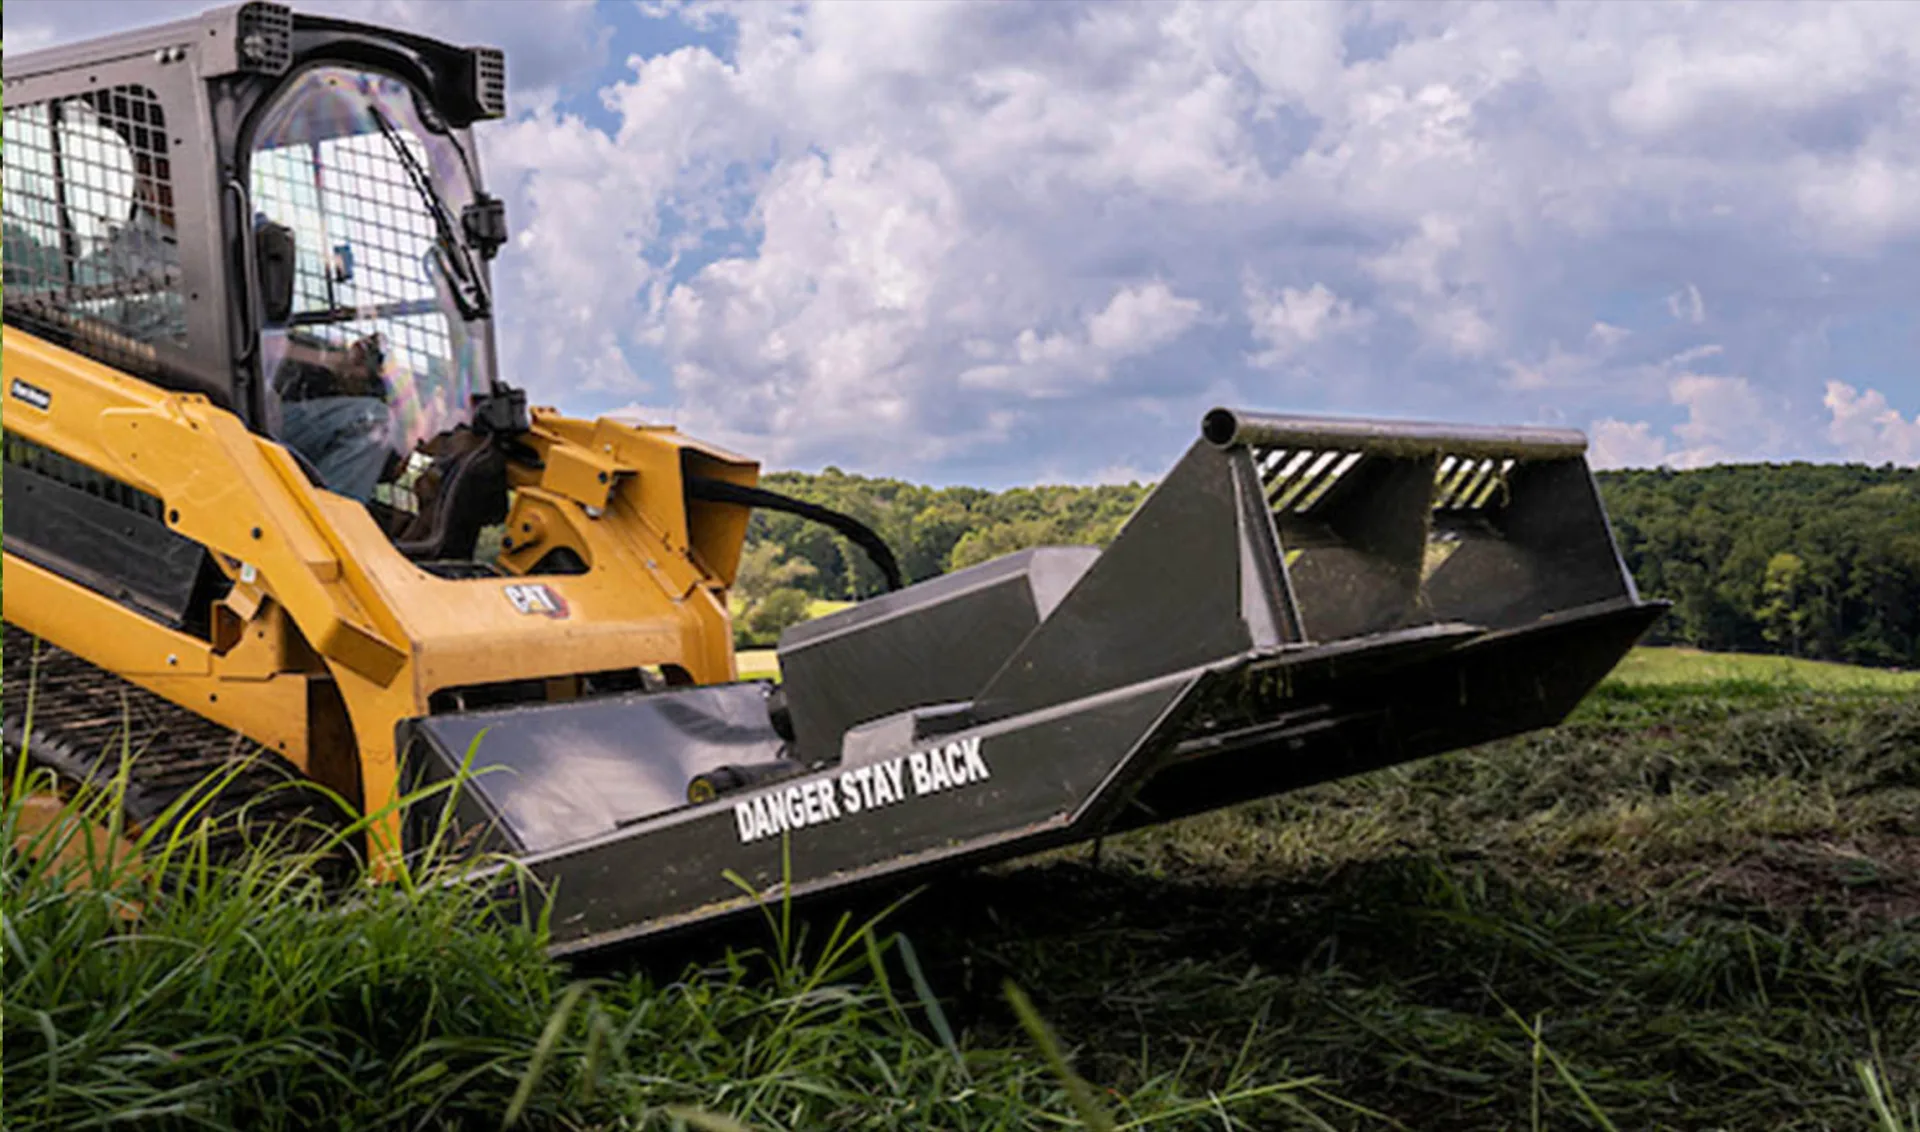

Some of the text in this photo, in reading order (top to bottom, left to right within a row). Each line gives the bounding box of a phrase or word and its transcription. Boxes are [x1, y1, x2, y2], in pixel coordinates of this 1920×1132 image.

[505, 585, 557, 613] CAT
[735, 736, 989, 843] DANGER STAY BACK
